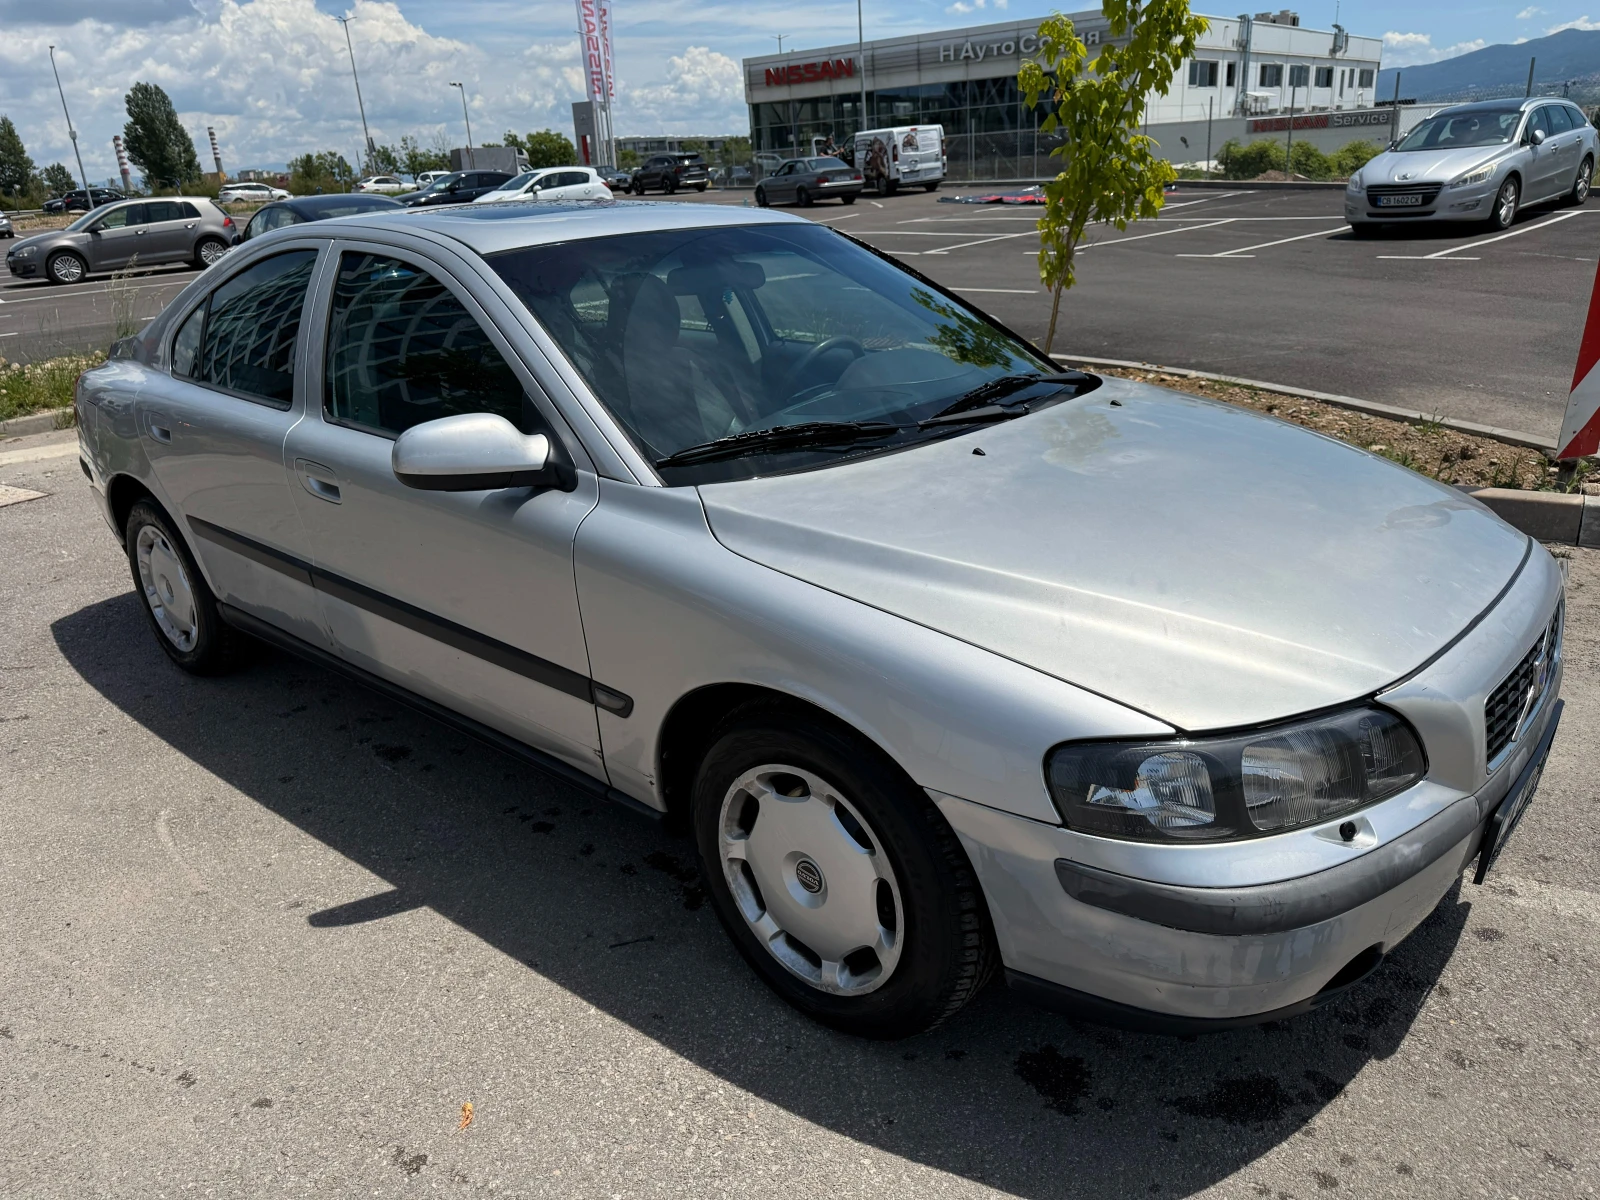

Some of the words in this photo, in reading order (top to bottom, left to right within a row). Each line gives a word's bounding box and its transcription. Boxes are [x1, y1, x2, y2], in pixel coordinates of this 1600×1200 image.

[765, 58, 852, 86] NISSAN
[1333, 113, 1388, 126] Service
[1393, 196, 1410, 205] 1602
